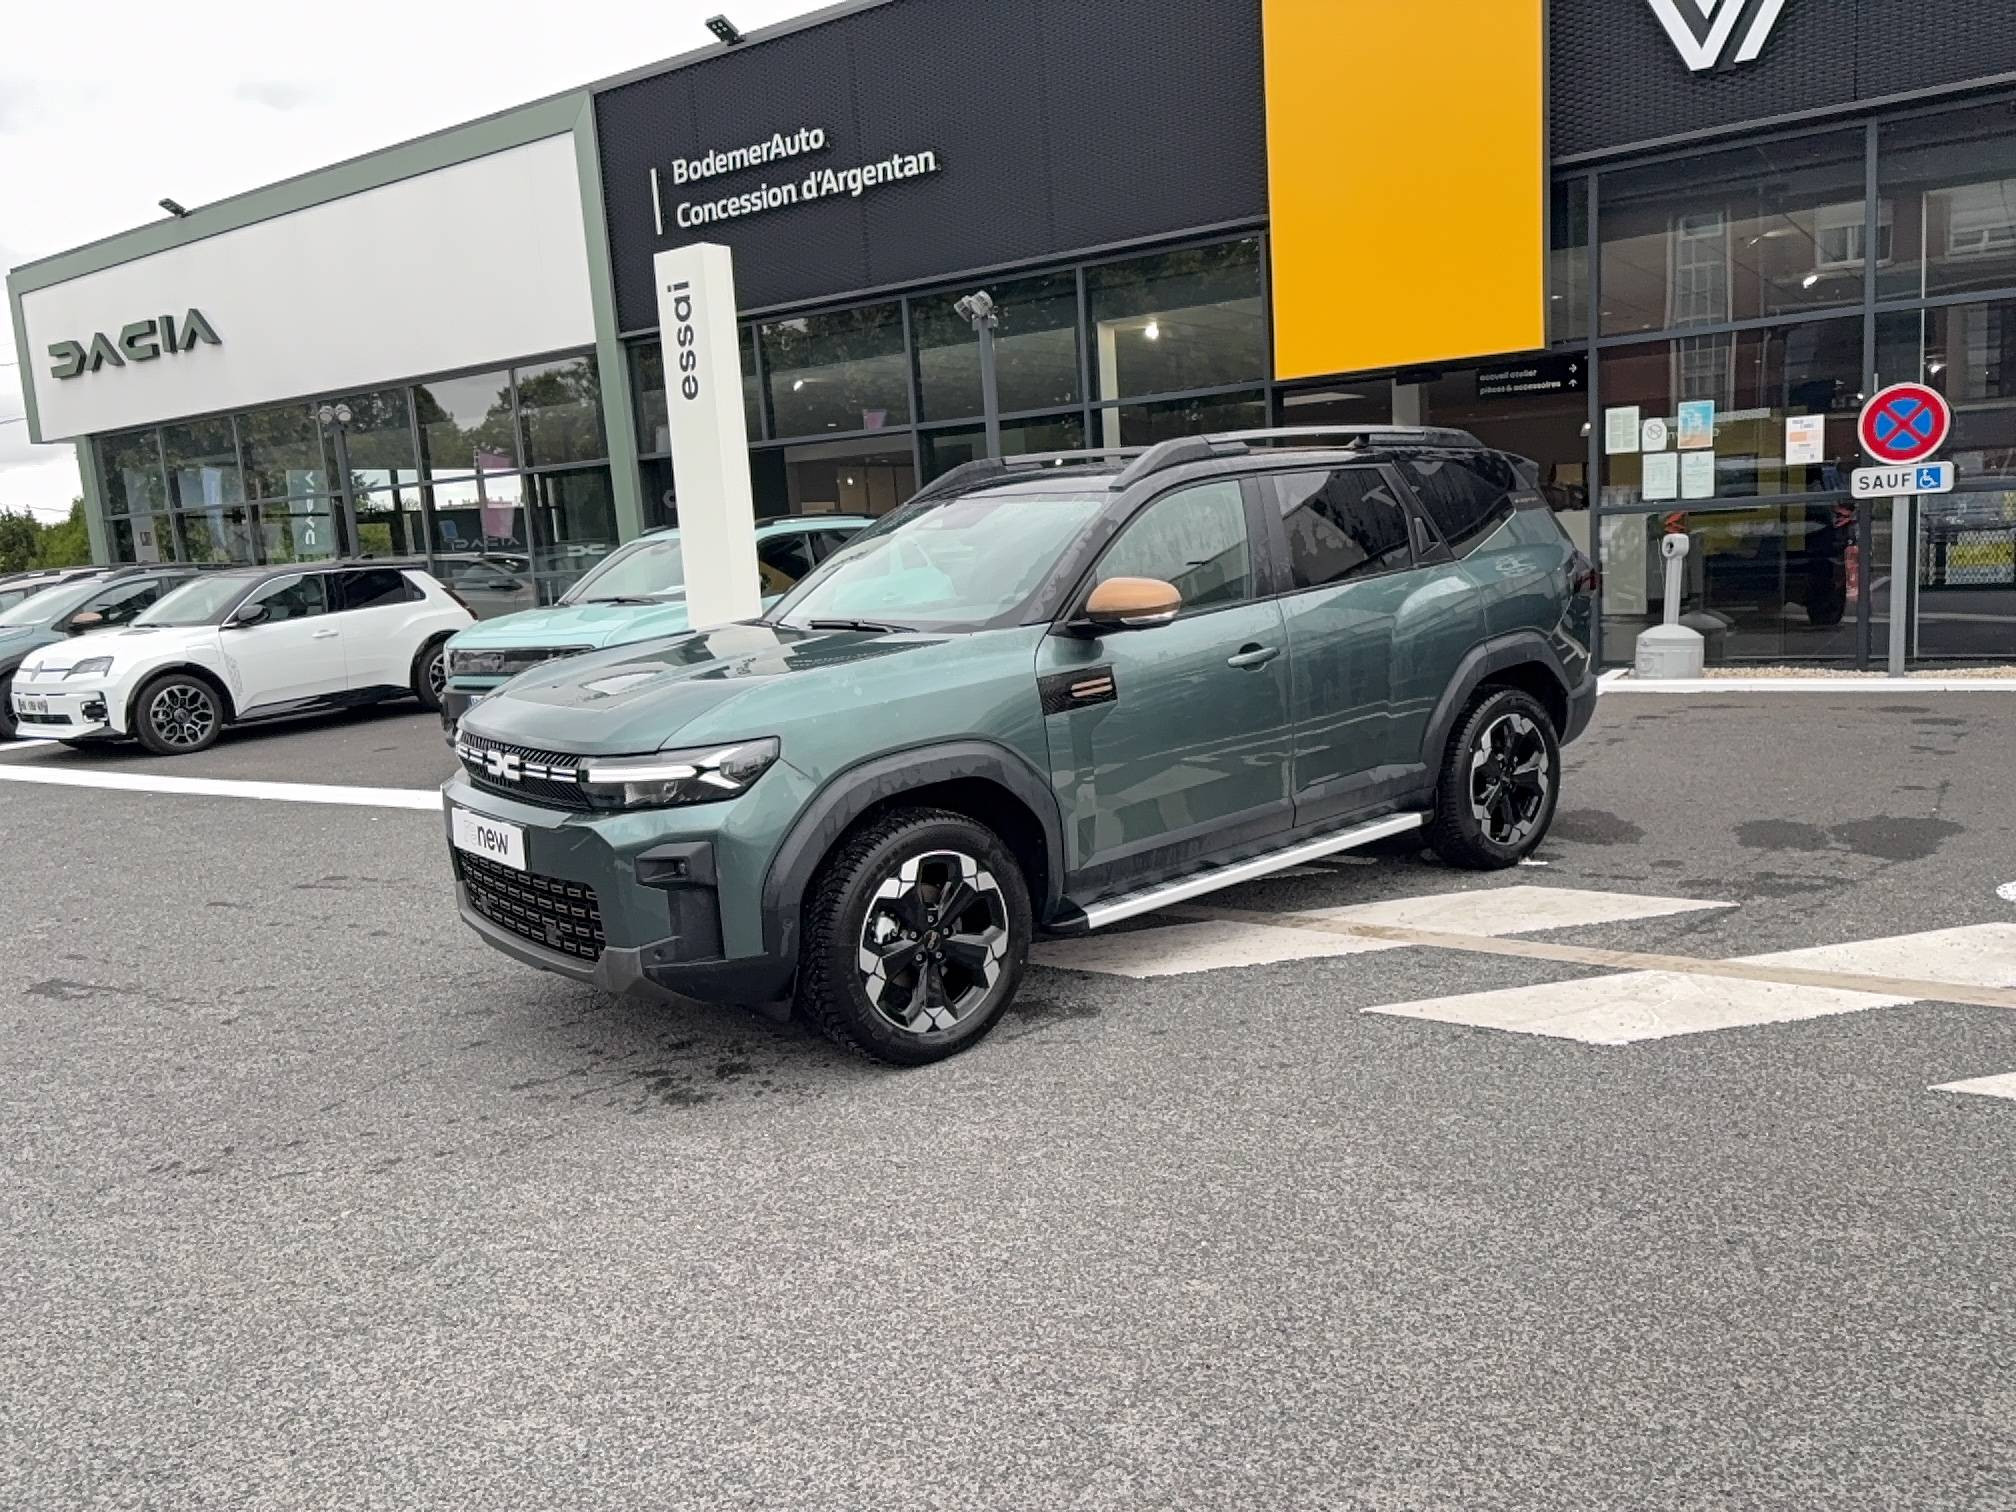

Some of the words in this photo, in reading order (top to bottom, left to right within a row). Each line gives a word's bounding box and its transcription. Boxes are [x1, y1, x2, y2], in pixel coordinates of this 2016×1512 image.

[672, 127, 825, 185] BodemerAuto
[676, 178, 798, 229] Concession
[802, 150, 937, 198] d'Argentan
[47, 308, 222, 379] DACIA
[667, 280, 699, 401] essai
[1858, 473, 1911, 490] SAUF
